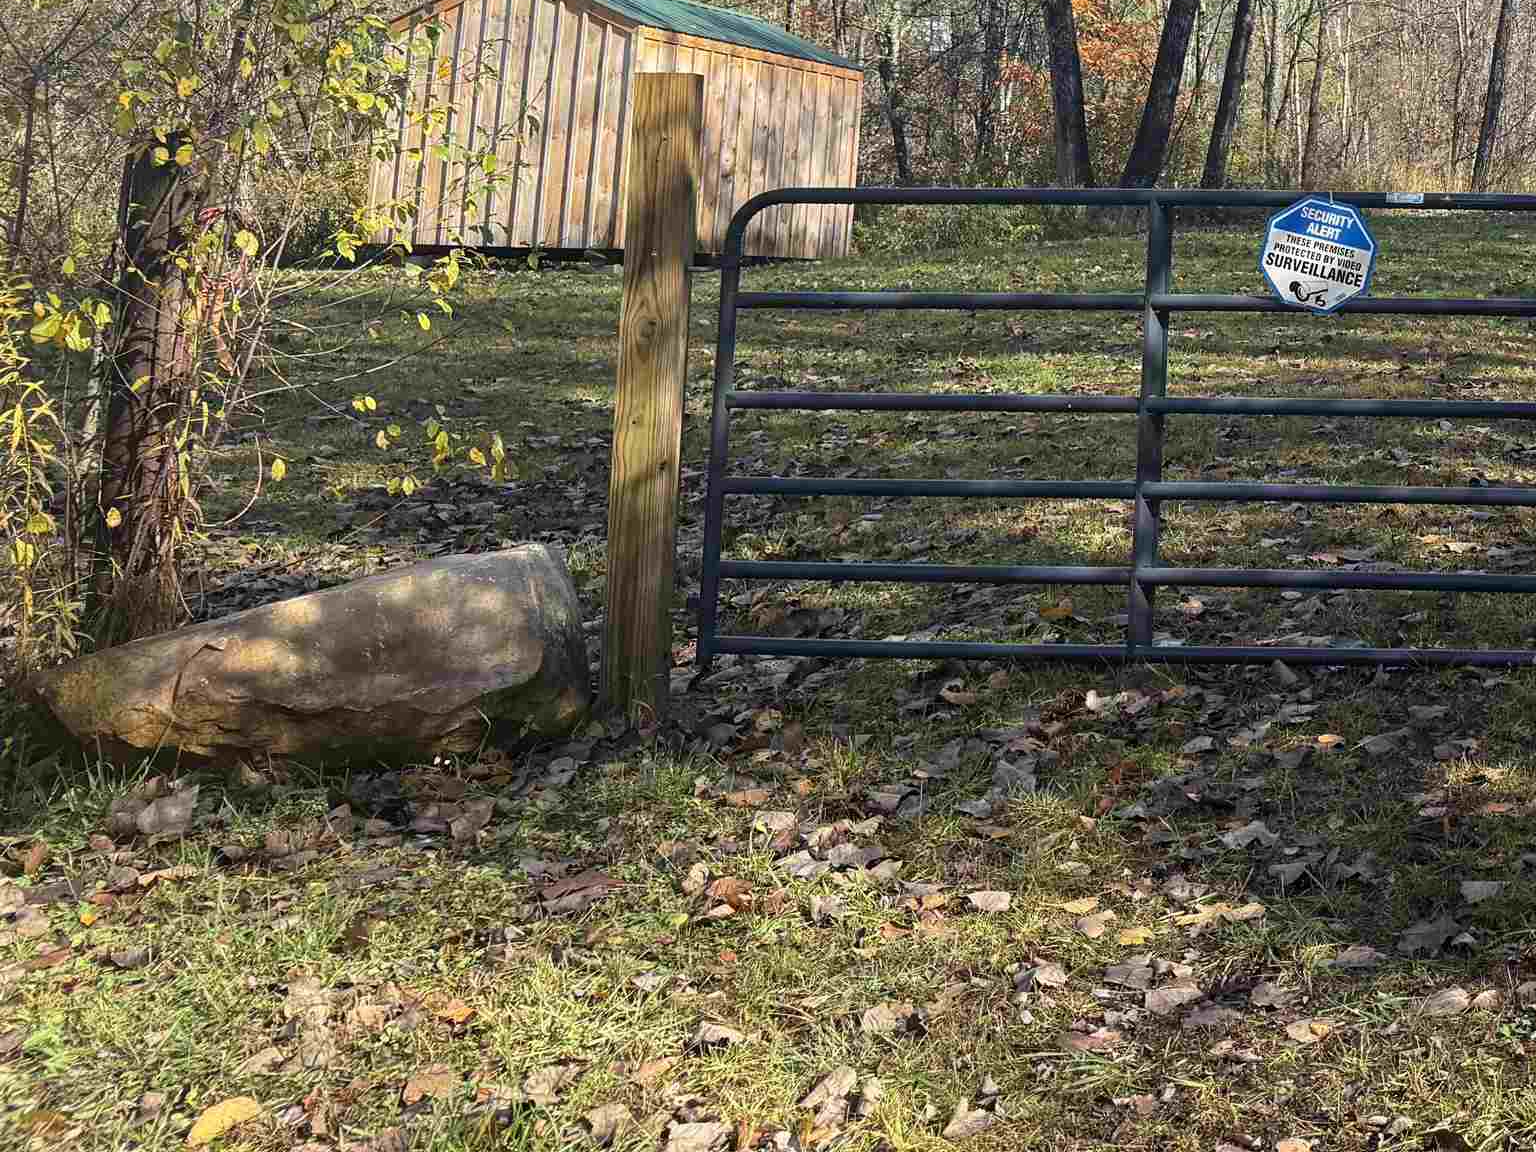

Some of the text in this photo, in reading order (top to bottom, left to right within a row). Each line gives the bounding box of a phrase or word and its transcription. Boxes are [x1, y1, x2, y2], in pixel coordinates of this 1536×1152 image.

[1301, 207, 1354, 228] SECURITY
[1306, 221, 1342, 240] ALERT
[1273, 242, 1362, 271] PROTECTED BY VIDEO
[1287, 234, 1355, 258] THESE PREMISES
[1266, 252, 1363, 287] SURVEILLANCE
